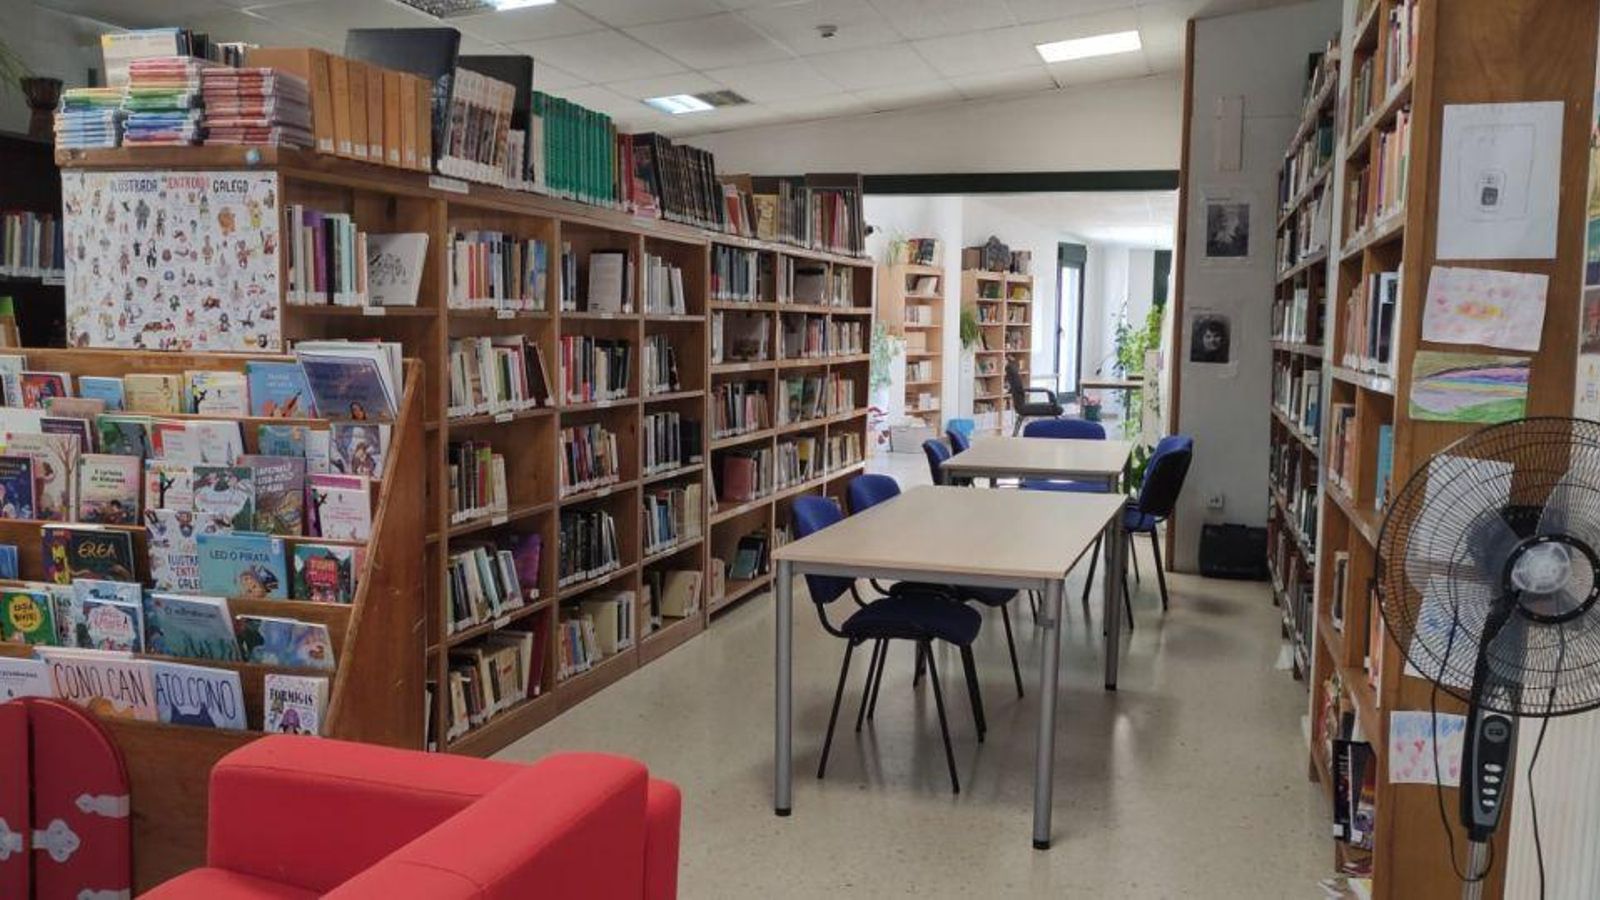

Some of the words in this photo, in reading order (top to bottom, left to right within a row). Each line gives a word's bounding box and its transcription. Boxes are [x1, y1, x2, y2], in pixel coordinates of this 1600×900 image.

[213, 180, 249, 193] GALEGO
[78, 541, 118, 559] EREA
[209, 550, 228, 560] LEO
[230, 551, 238, 561] O
[54, 663, 104, 700] CONO
[107, 667, 148, 707] CAN
